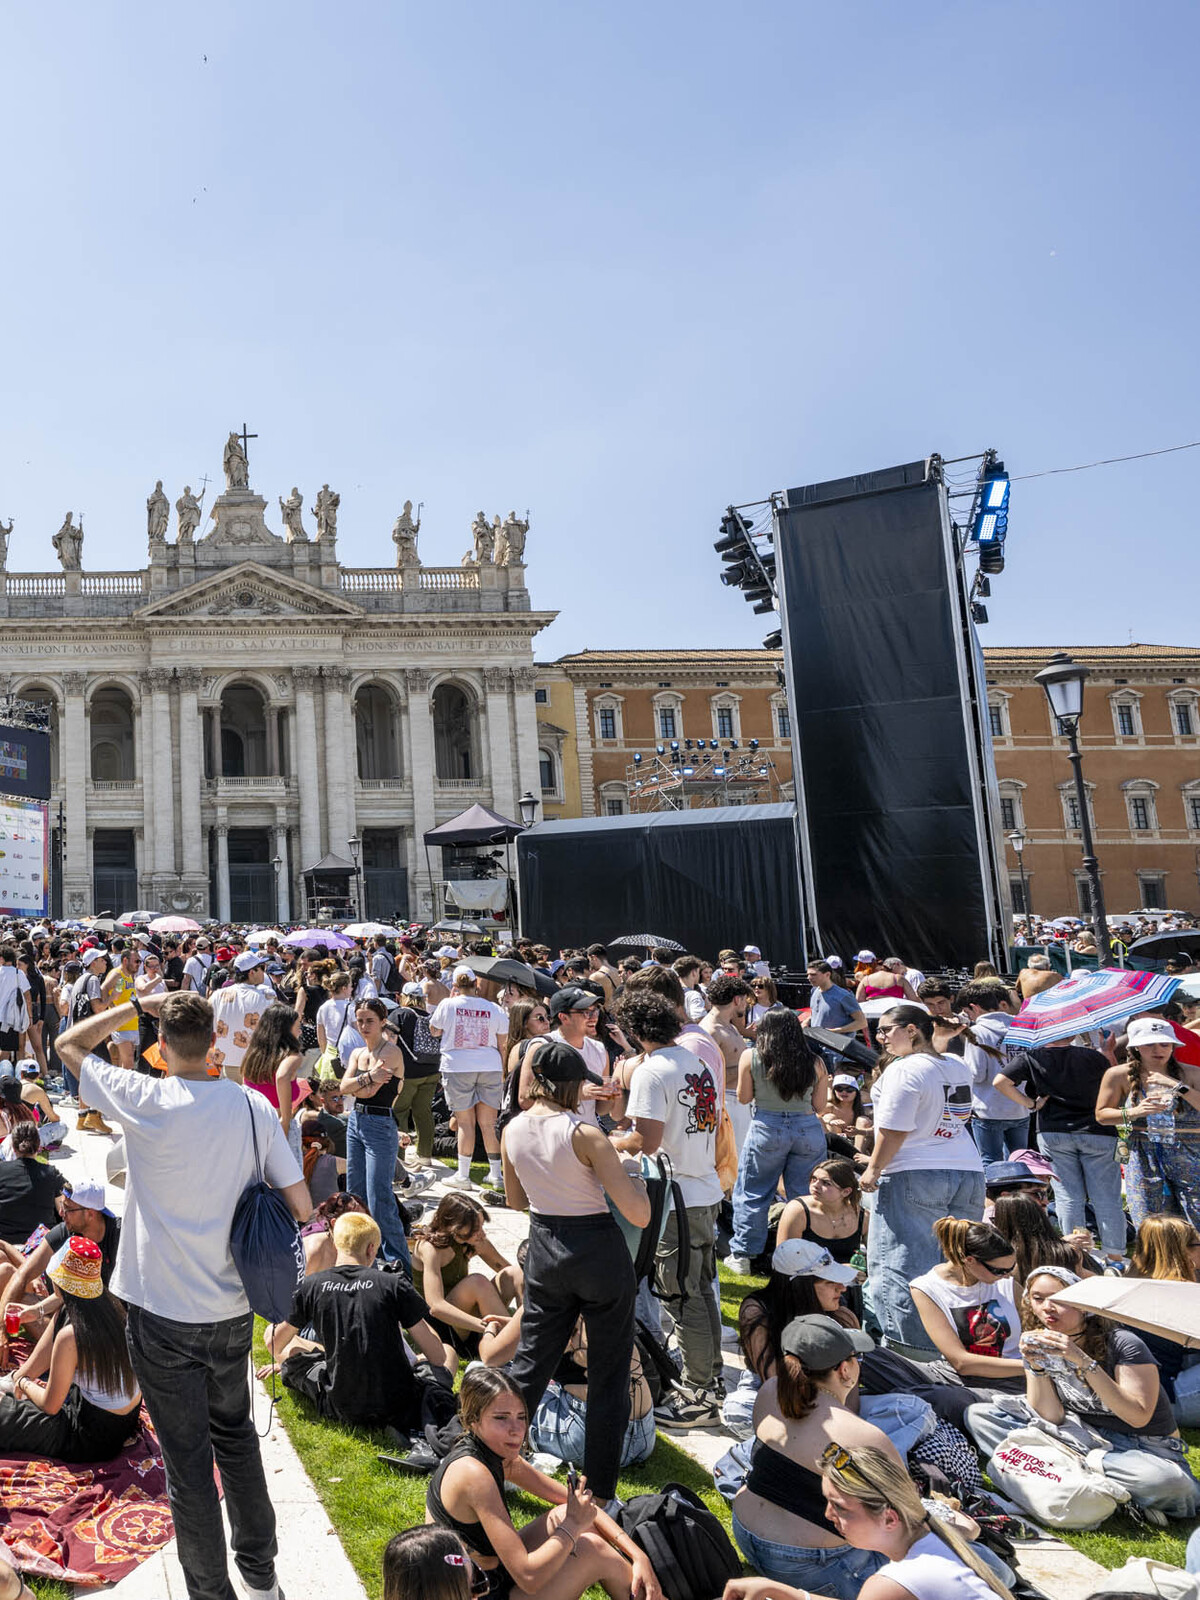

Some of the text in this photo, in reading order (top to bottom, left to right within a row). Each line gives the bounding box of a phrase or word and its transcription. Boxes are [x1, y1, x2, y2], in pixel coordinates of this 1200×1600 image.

[38, 645, 68, 655] PONT
[73, 645, 98, 653] MAX
[104, 644, 136, 653] ANNO
[358, 641, 384, 650] HON
[321, 1280, 374, 1293] THAILAND
[1023, 1462, 1062, 1483] DESIGN
